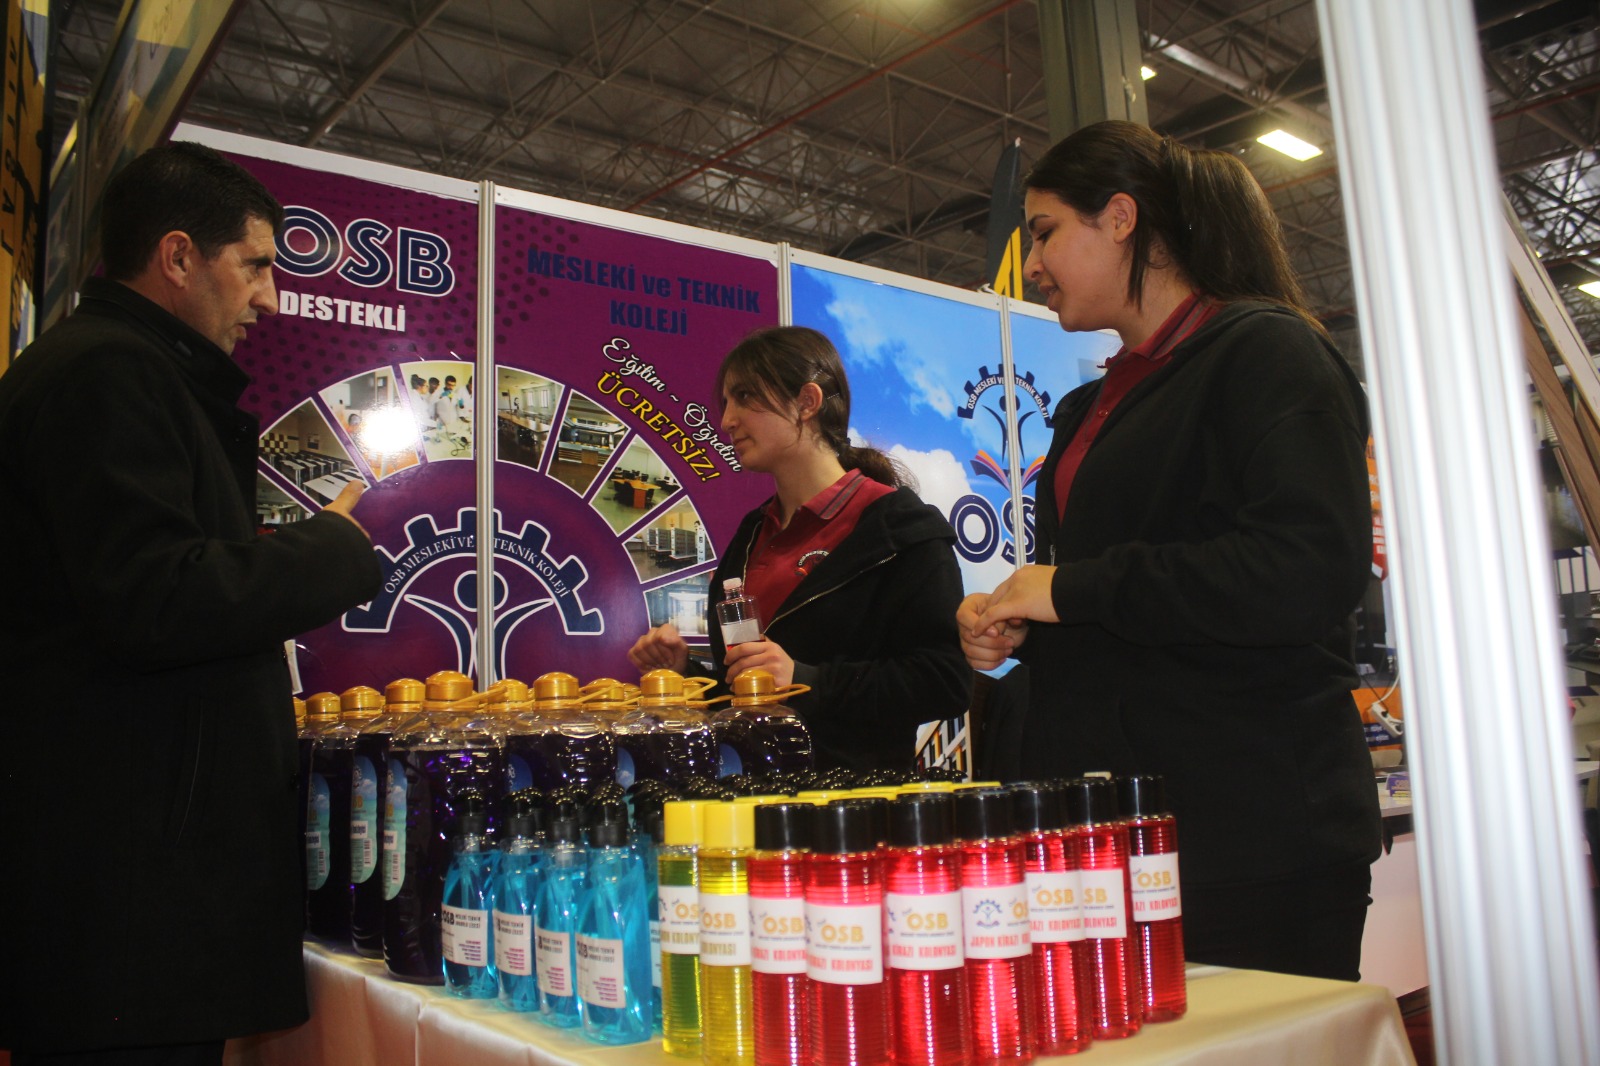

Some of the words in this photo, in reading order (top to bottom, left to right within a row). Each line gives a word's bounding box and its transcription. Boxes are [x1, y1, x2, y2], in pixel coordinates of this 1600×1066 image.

[274, 205, 455, 297] OSB
[527, 247, 636, 292] MESLEKİ
[642, 273, 671, 298] ve
[676, 276, 761, 314] TEKNİK
[279, 290, 406, 332] DESTEKLİ
[610, 300, 688, 336] KOLEJİ
[597, 371, 721, 482] ÜCRETSİZ!
[384, 569, 406, 594] OSB
[406, 536, 456, 572] MESLEKİ
[458, 536, 475, 548] VE
[494, 537, 536, 564] TEKNİK
[535, 559, 571, 598] KOLEJİ
[1137, 870, 1172, 887] OSB
[1036, 888, 1075, 906] OSB
[1083, 888, 1108, 904] SB
[701, 911, 737, 928] OSB
[763, 916, 804, 934] OSB
[906, 912, 949, 931] OSB
[1084, 916, 1117, 930] OLONYASI
[821, 924, 864, 943] OSB
